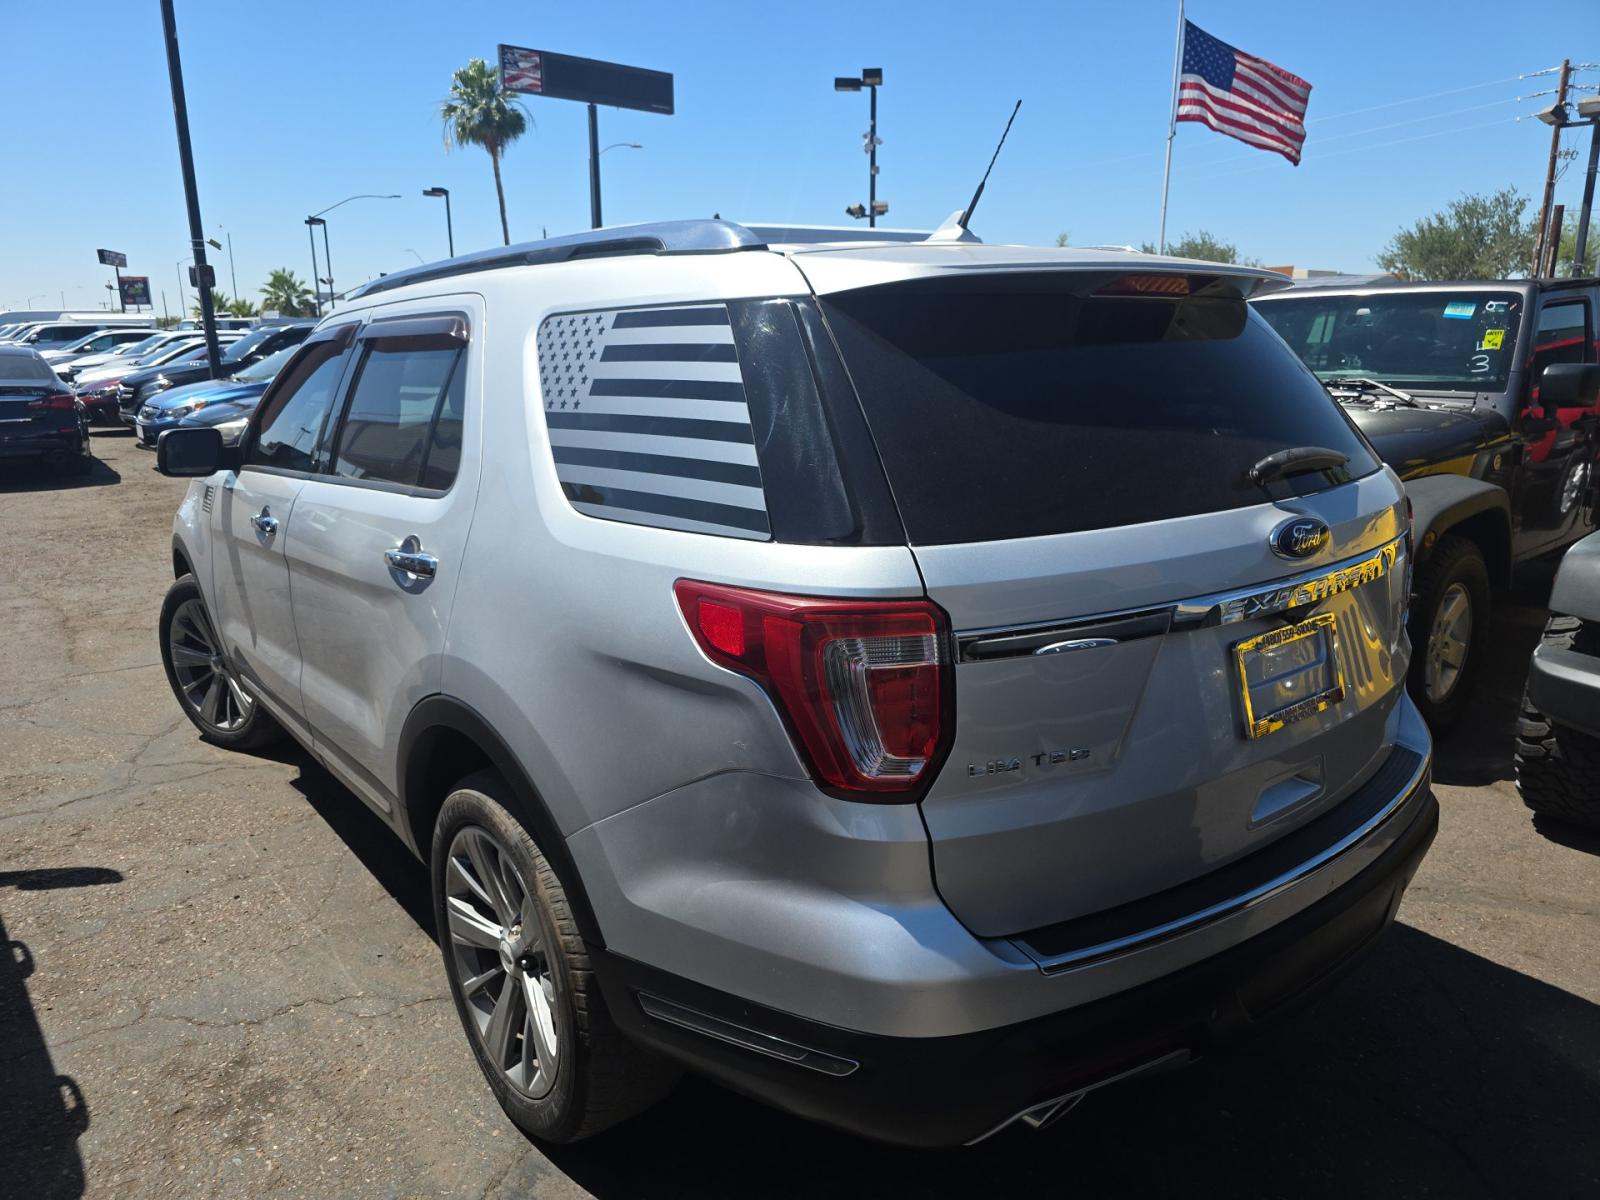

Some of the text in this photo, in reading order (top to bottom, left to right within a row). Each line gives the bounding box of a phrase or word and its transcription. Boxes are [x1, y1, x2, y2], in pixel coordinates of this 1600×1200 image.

[1471, 354, 1490, 373] 3
[1291, 524, 1322, 552] Ford
[968, 747, 1090, 777] LIMTED
